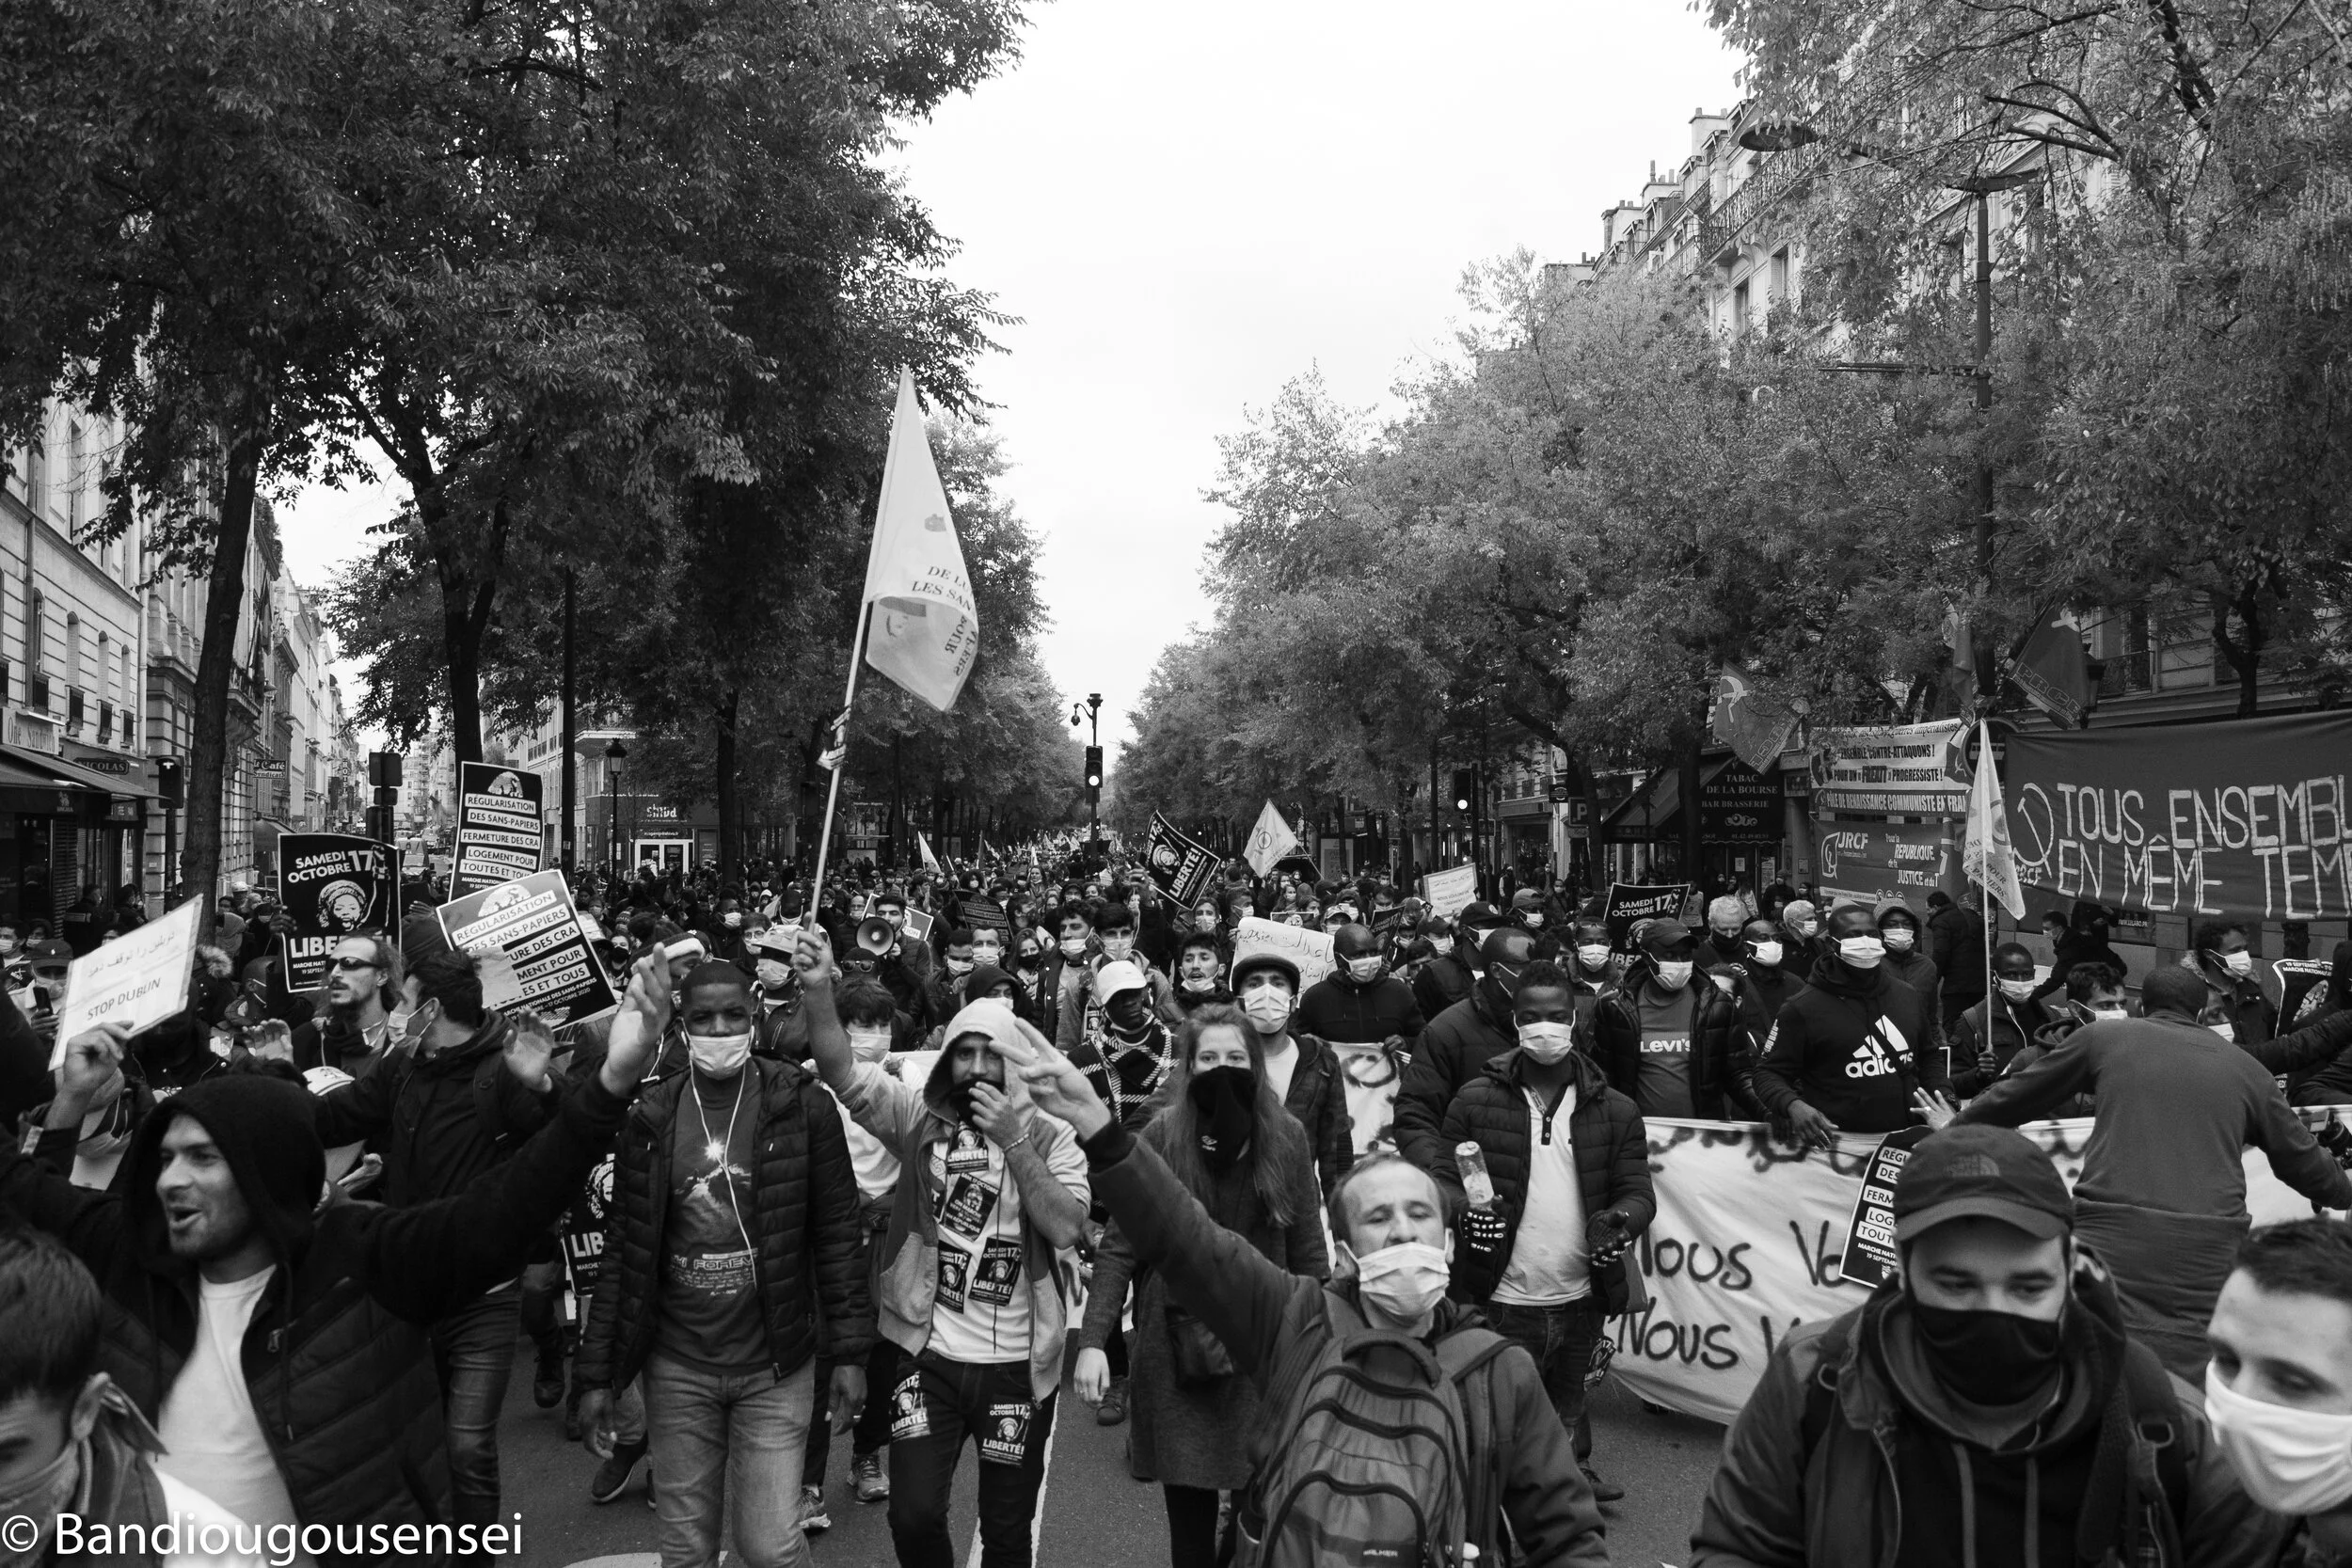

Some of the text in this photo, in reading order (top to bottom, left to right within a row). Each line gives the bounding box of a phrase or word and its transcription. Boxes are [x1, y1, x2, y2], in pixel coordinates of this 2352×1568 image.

[928, 565, 973, 594] DE LU
[912, 579, 973, 611] LES SAN
[1725, 774, 1759, 783] TABAC
[1892, 768, 1939, 782] PROGRESSISTE
[1739, 785, 1778, 794] BOURSE
[468, 794, 534, 811] RÉGULARISATION
[1887, 794, 1936, 811] COMMUNISTE
[2058, 775, 2352, 848] TOUS ENSEMBL
[470, 812, 538, 831] DES SANS-PAPIERS
[463, 832, 539, 847] FERMETURE DES CRA
[1838, 832, 1868, 849] JRCF
[295, 851, 346, 869] SAMEDI
[348, 850, 373, 872] 17
[468, 849, 534, 865] LOGEMENT POUR
[287, 863, 352, 883] OCTOBRE
[464, 863, 500, 875] TOUTES
[501, 867, 510, 876] ET
[1168, 847, 1202, 897] LIBERTÉ!
[1898, 870, 1924, 886] JUSTICE
[2058, 834, 2352, 919] EN MÊME TEM
[1612, 906, 1654, 917] OCTOBRE
[1619, 898, 1653, 909] SAMEDI
[1655, 894, 1672, 911] 17
[456, 894, 552, 942] RÉGULARISATION
[489, 908, 566, 946] SANS-PAPIERS
[532, 937, 553, 952] DES
[553, 926, 577, 942] CRA
[517, 949, 582, 981] MENT POUR
[522, 968, 585, 996] ES ET TOUS
[87, 977, 161, 1021] STOP DUBLIN
[579, 988, 591, 996] 2020
[1789, 1220, 1844, 1288] Vo
[1857, 1243, 1882, 1255] MARCHE
[891, 1411, 928, 1433] LIBERTÉ!
[983, 1438, 1025, 1456] LIBERTÉ!
